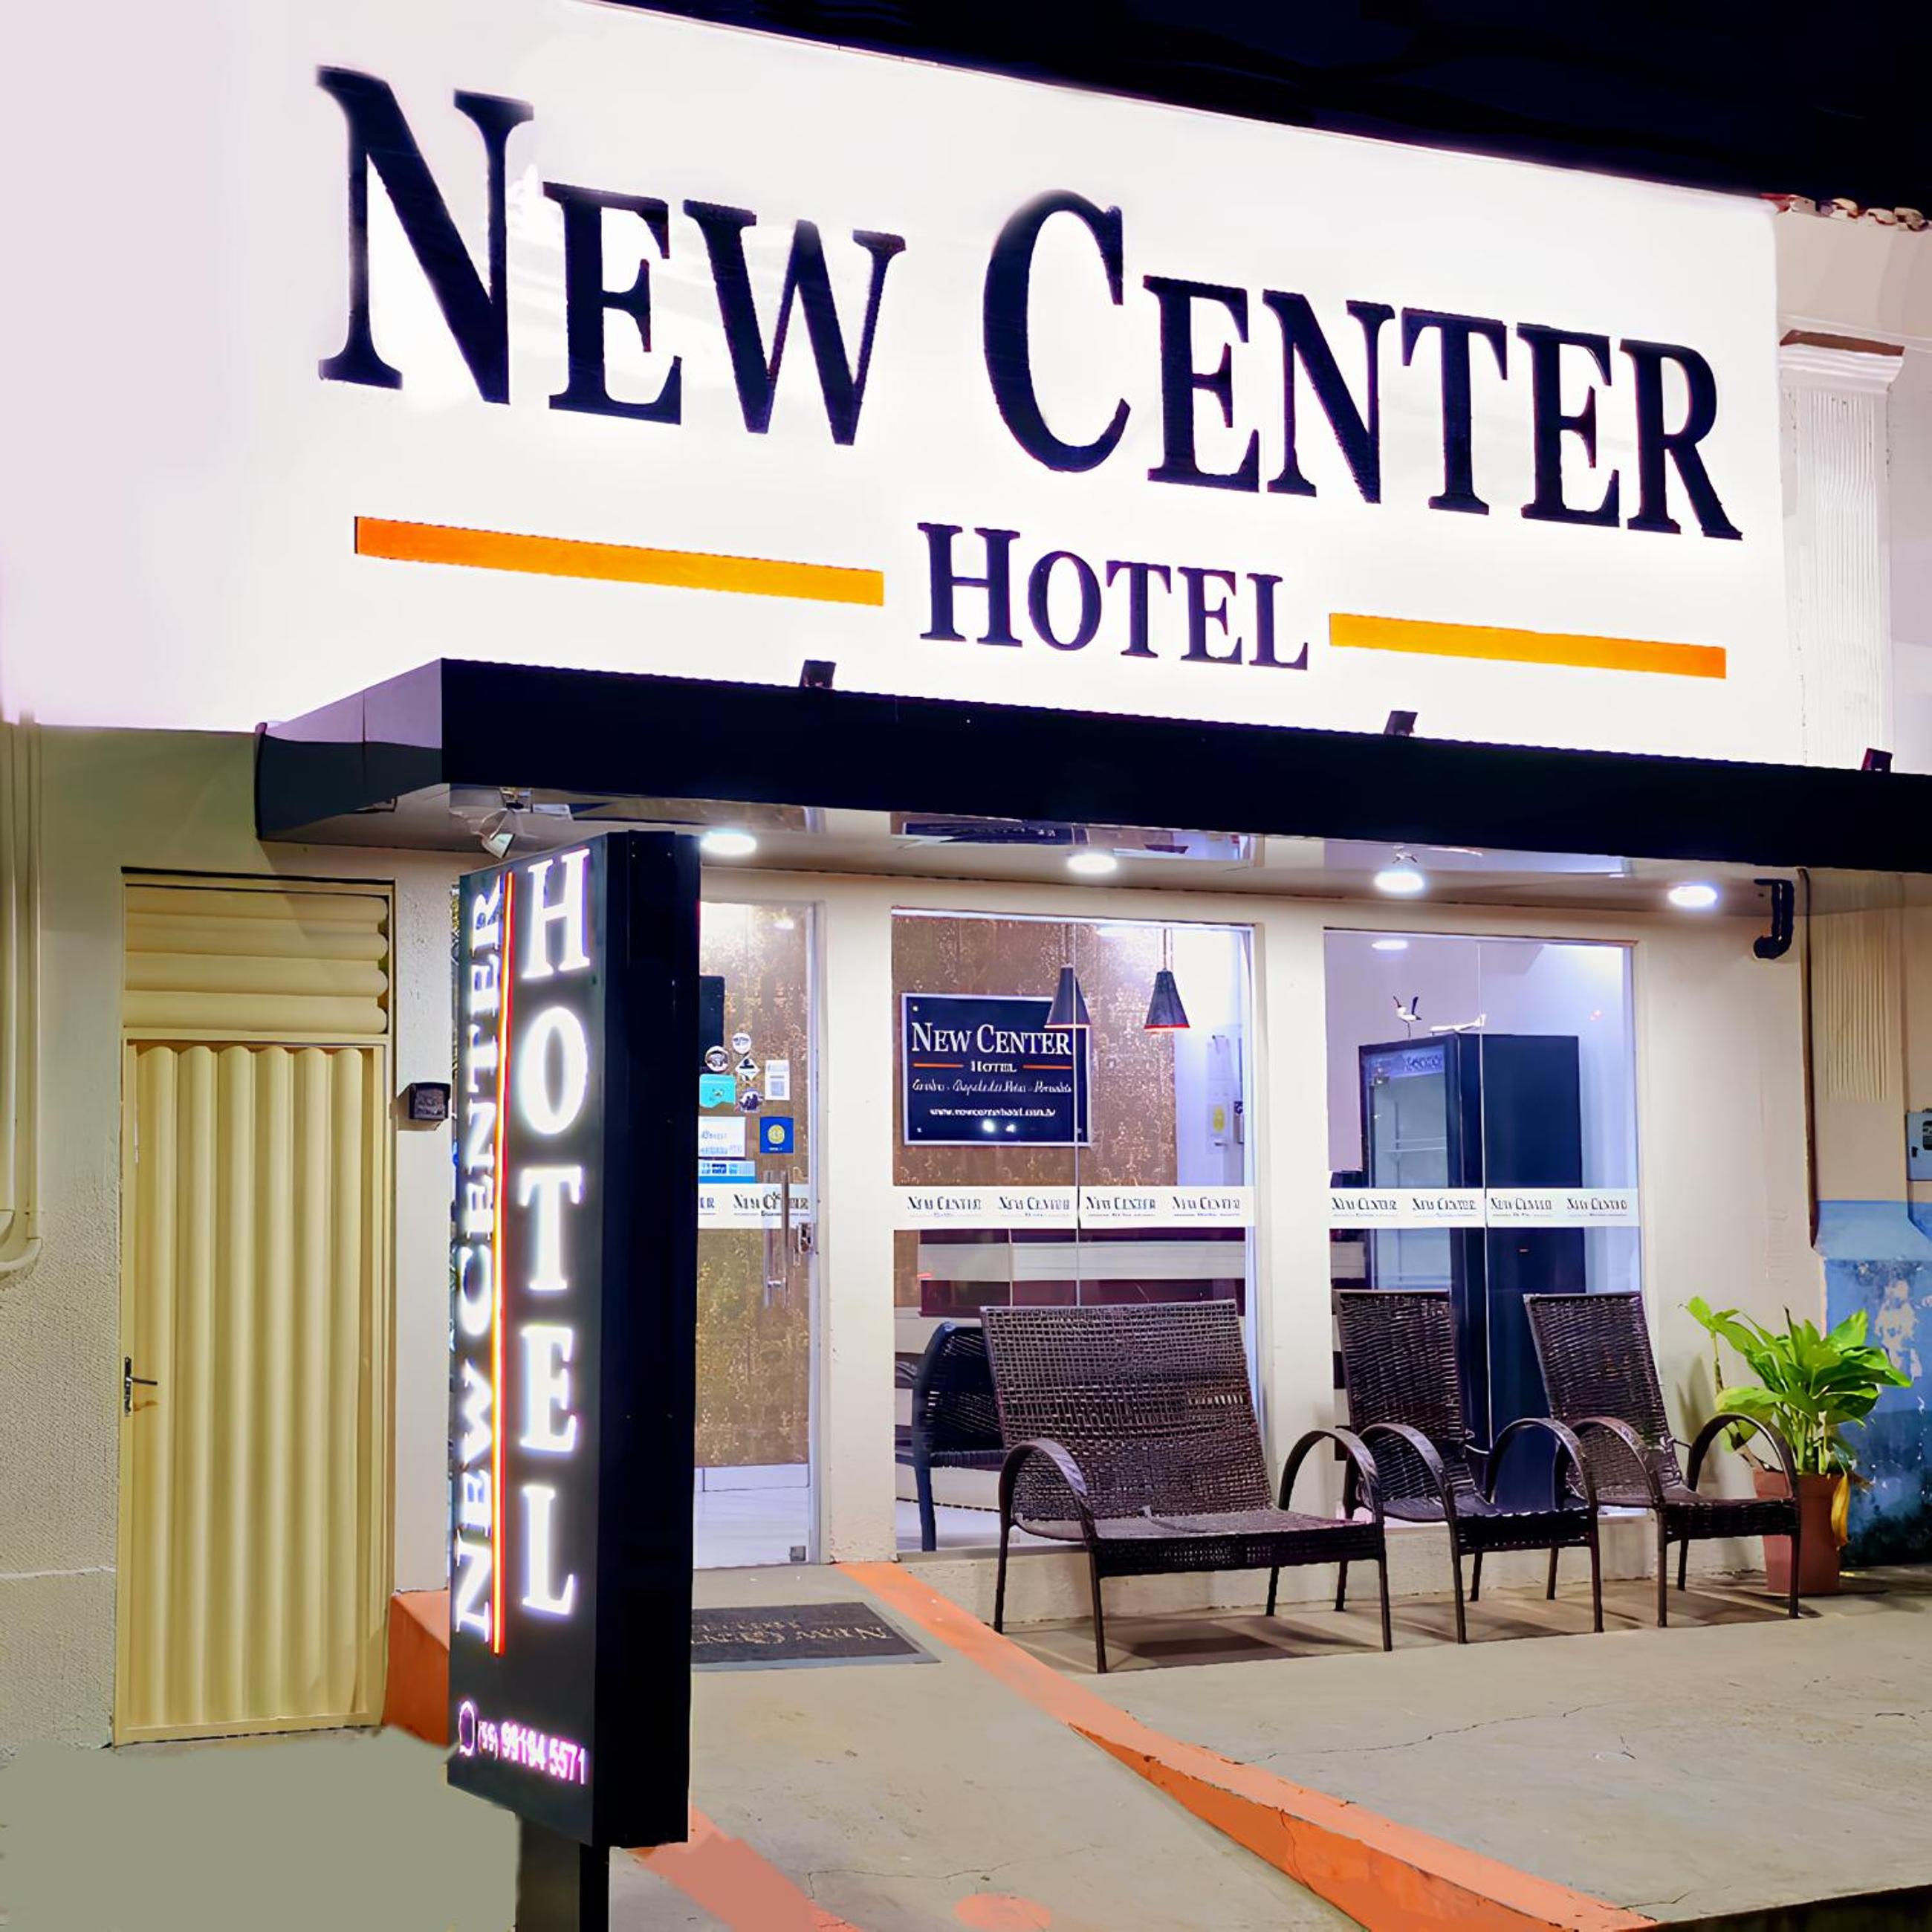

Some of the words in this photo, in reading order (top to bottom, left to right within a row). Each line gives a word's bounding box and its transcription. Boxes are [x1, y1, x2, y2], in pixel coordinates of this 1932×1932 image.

[316, 65, 907, 445] NEW
[983, 189, 1743, 540] CENTER
[917, 522, 1309, 670] HOTEL
[454, 874, 502, 1336] CENTER
[912, 1022, 972, 1052] NEW
[976, 1024, 1072, 1055] CENTER
[970, 1060, 1017, 1072] HOTEL
[519, 848, 591, 1615] HOTEL
[456, 1358, 493, 1644] NEW
[549, 1737, 586, 1785] 5571
